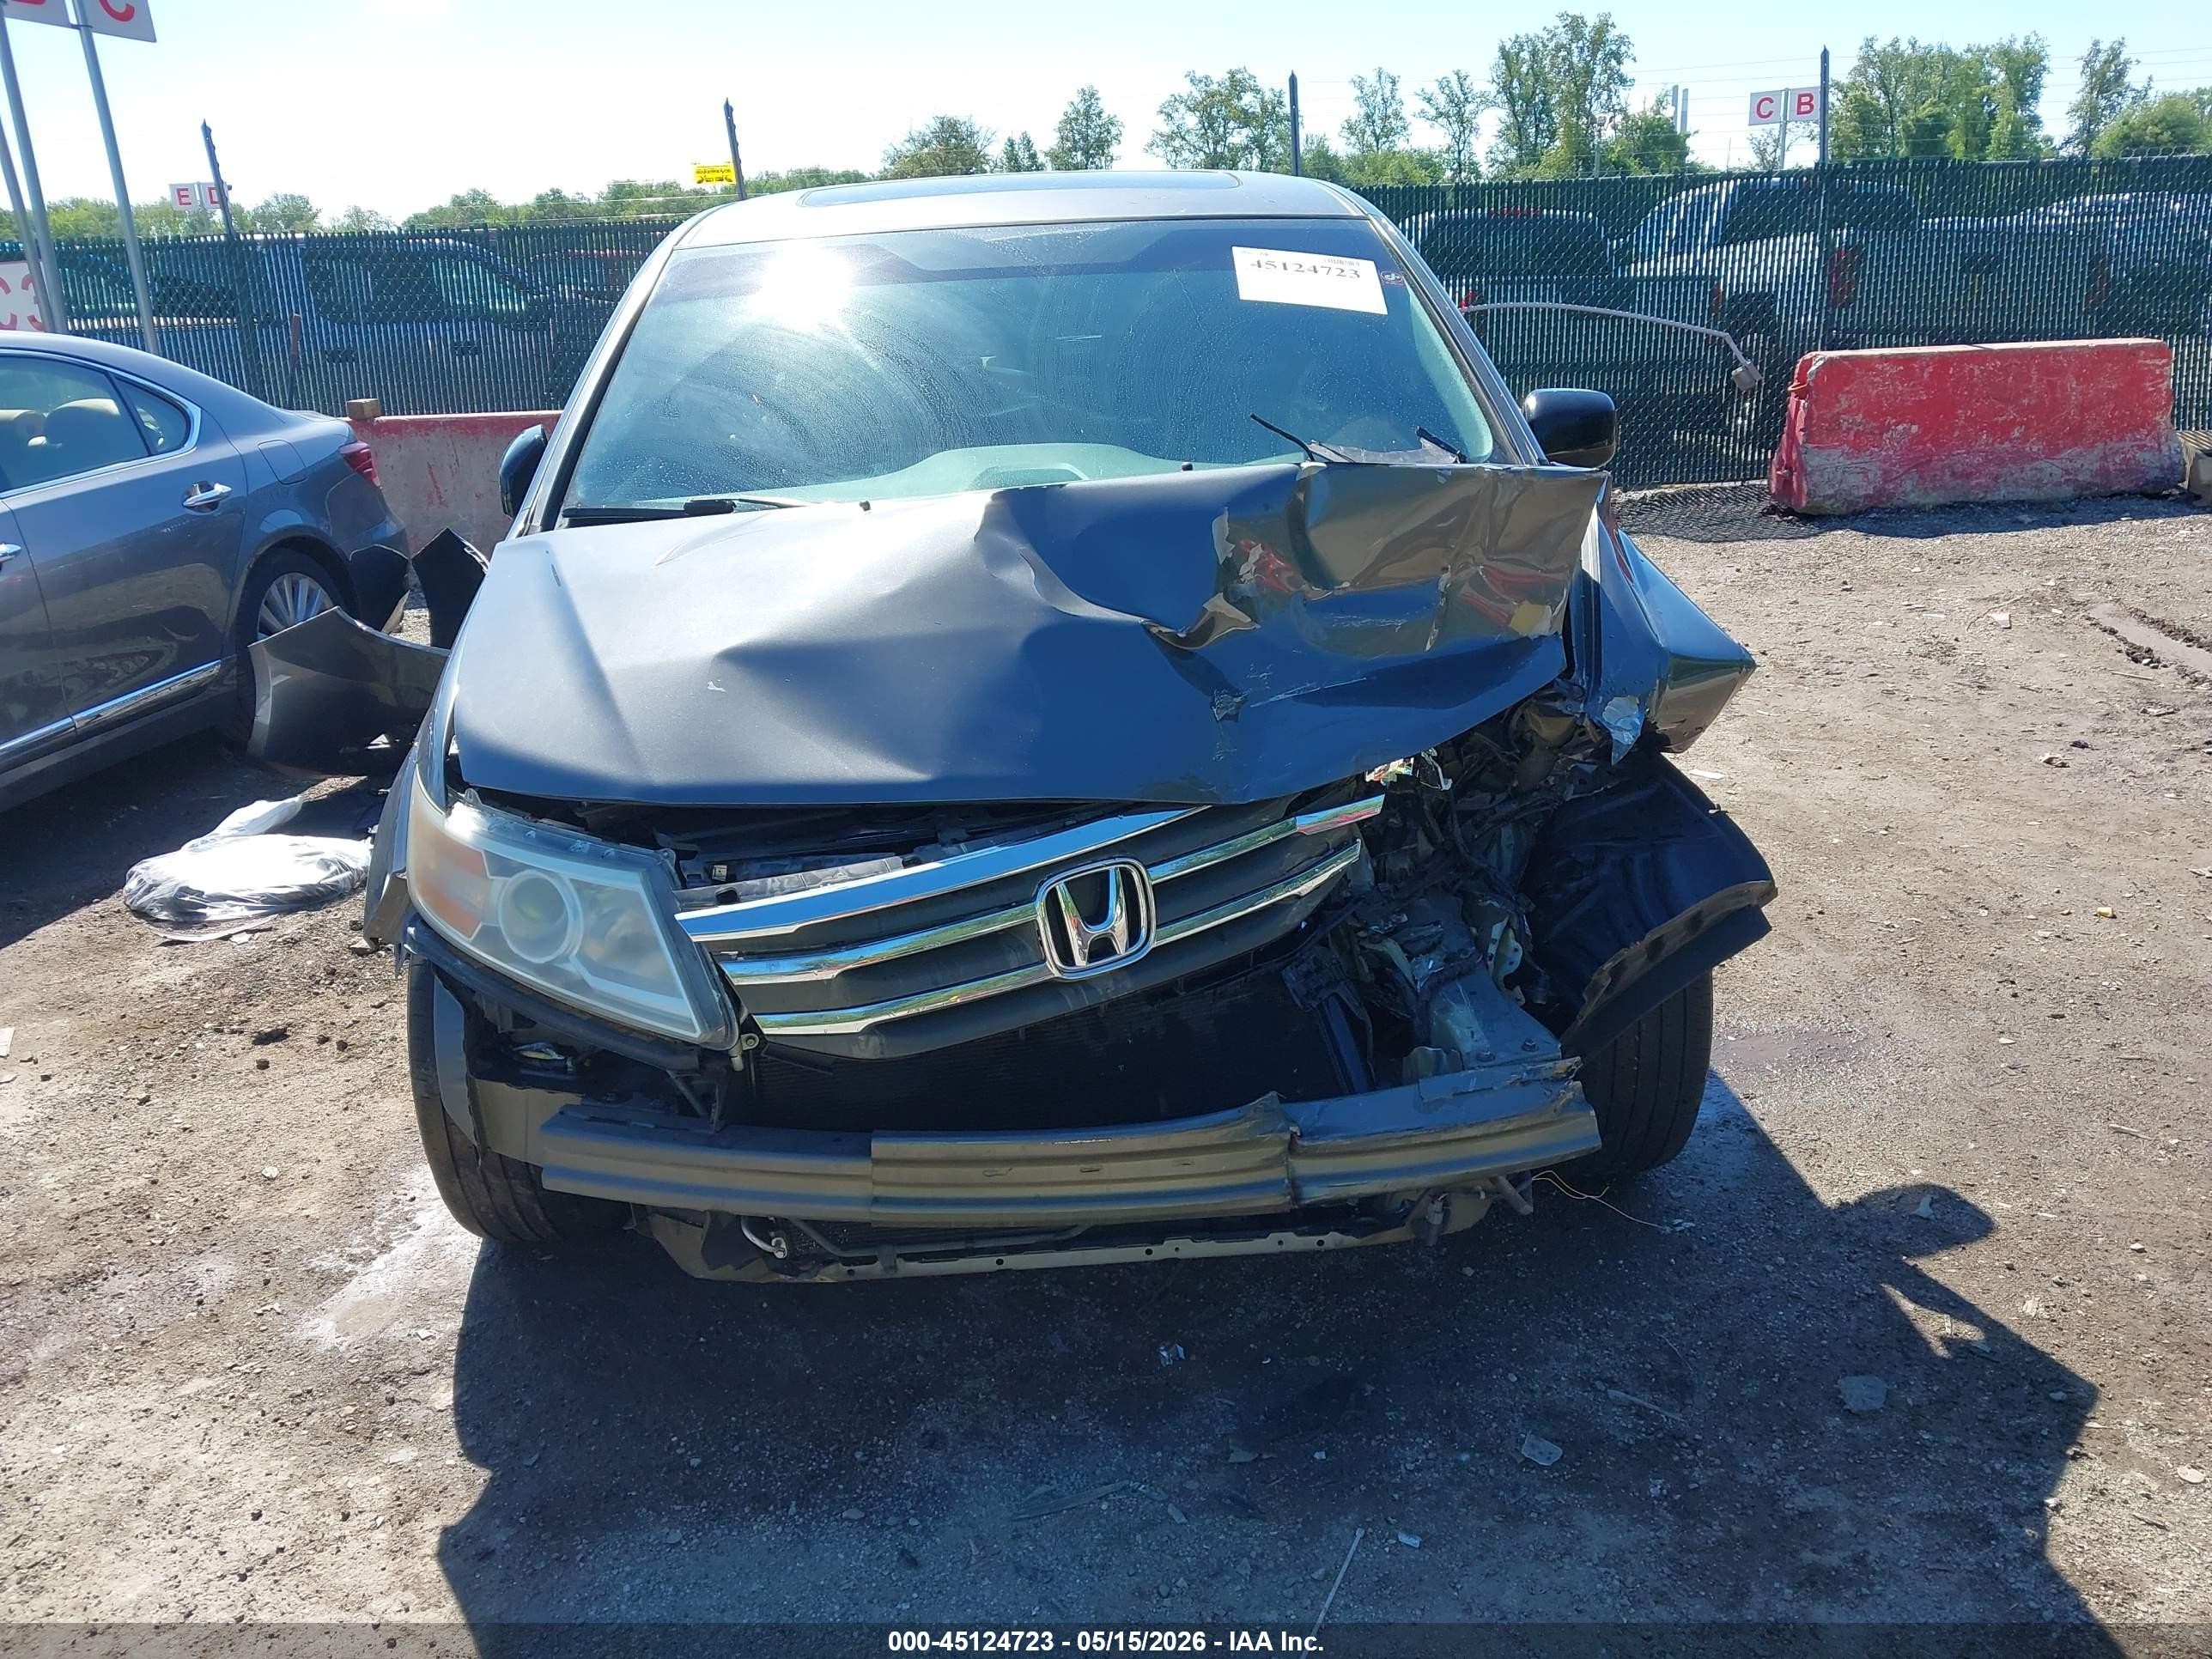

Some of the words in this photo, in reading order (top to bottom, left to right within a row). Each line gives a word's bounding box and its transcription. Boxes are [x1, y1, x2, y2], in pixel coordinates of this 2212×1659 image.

[1756, 96, 1774, 118] C
[1796, 93, 1814, 115] B
[176, 187, 191, 205] E
[1250, 259, 1361, 279] 45124723
